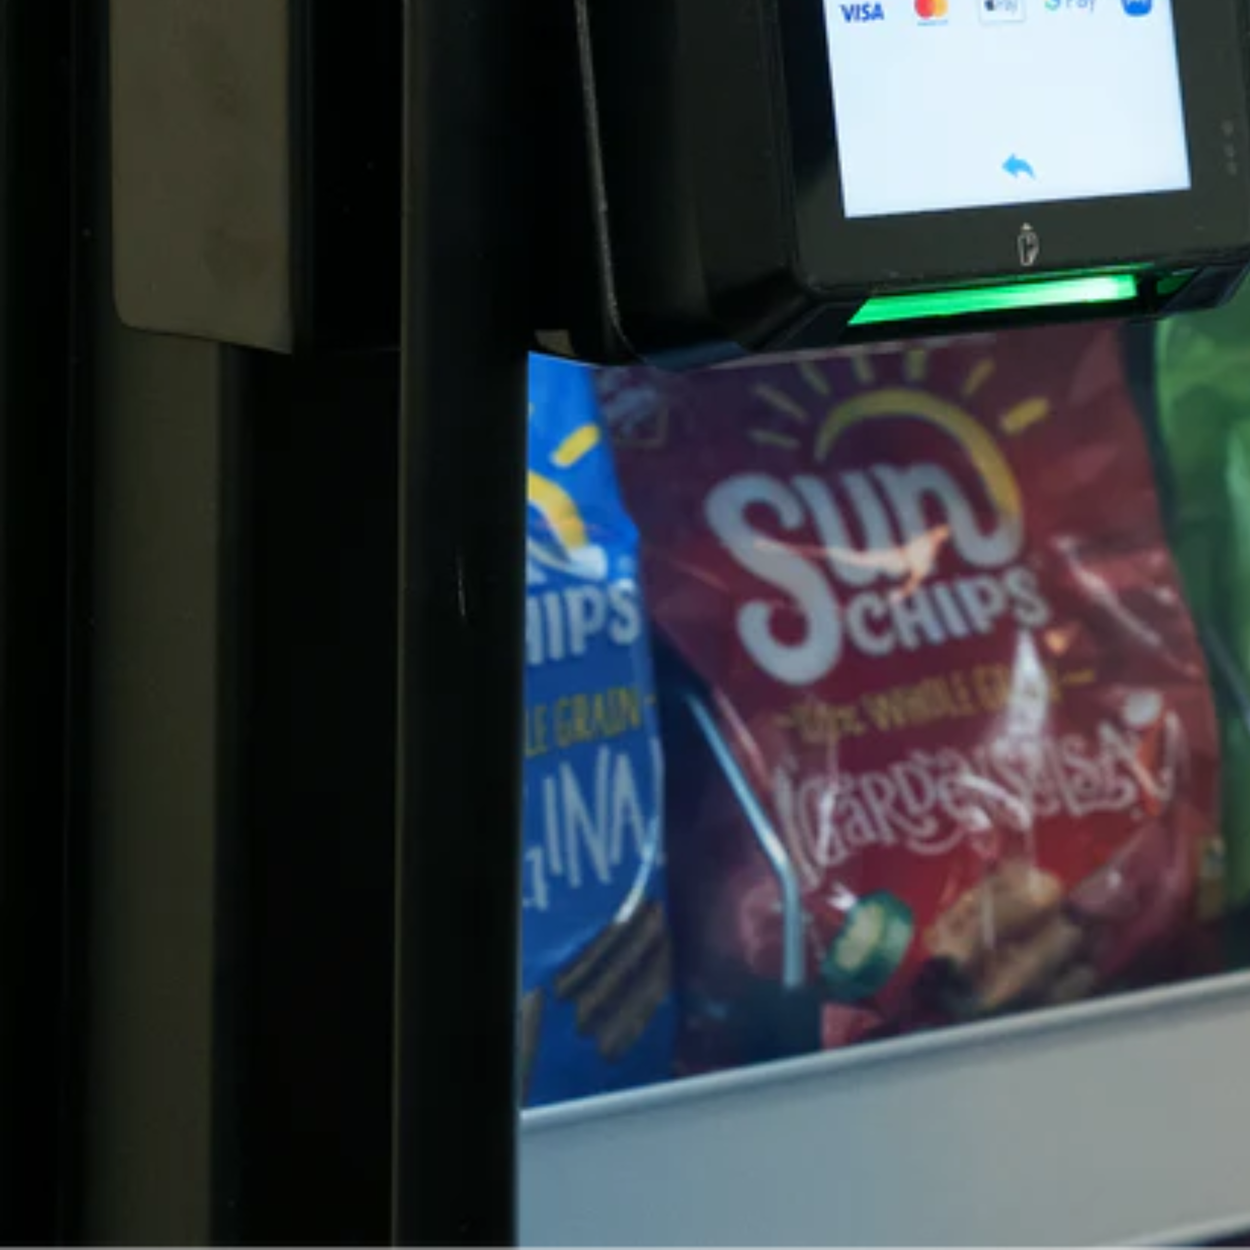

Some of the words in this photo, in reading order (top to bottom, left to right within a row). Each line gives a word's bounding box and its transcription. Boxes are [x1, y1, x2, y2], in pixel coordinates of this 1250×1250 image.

[840, 1, 885, 24] VISA
[703, 462, 1023, 687] Sun
[846, 566, 1050, 657] CHIPS
[862, 672, 974, 732] WHOLE
